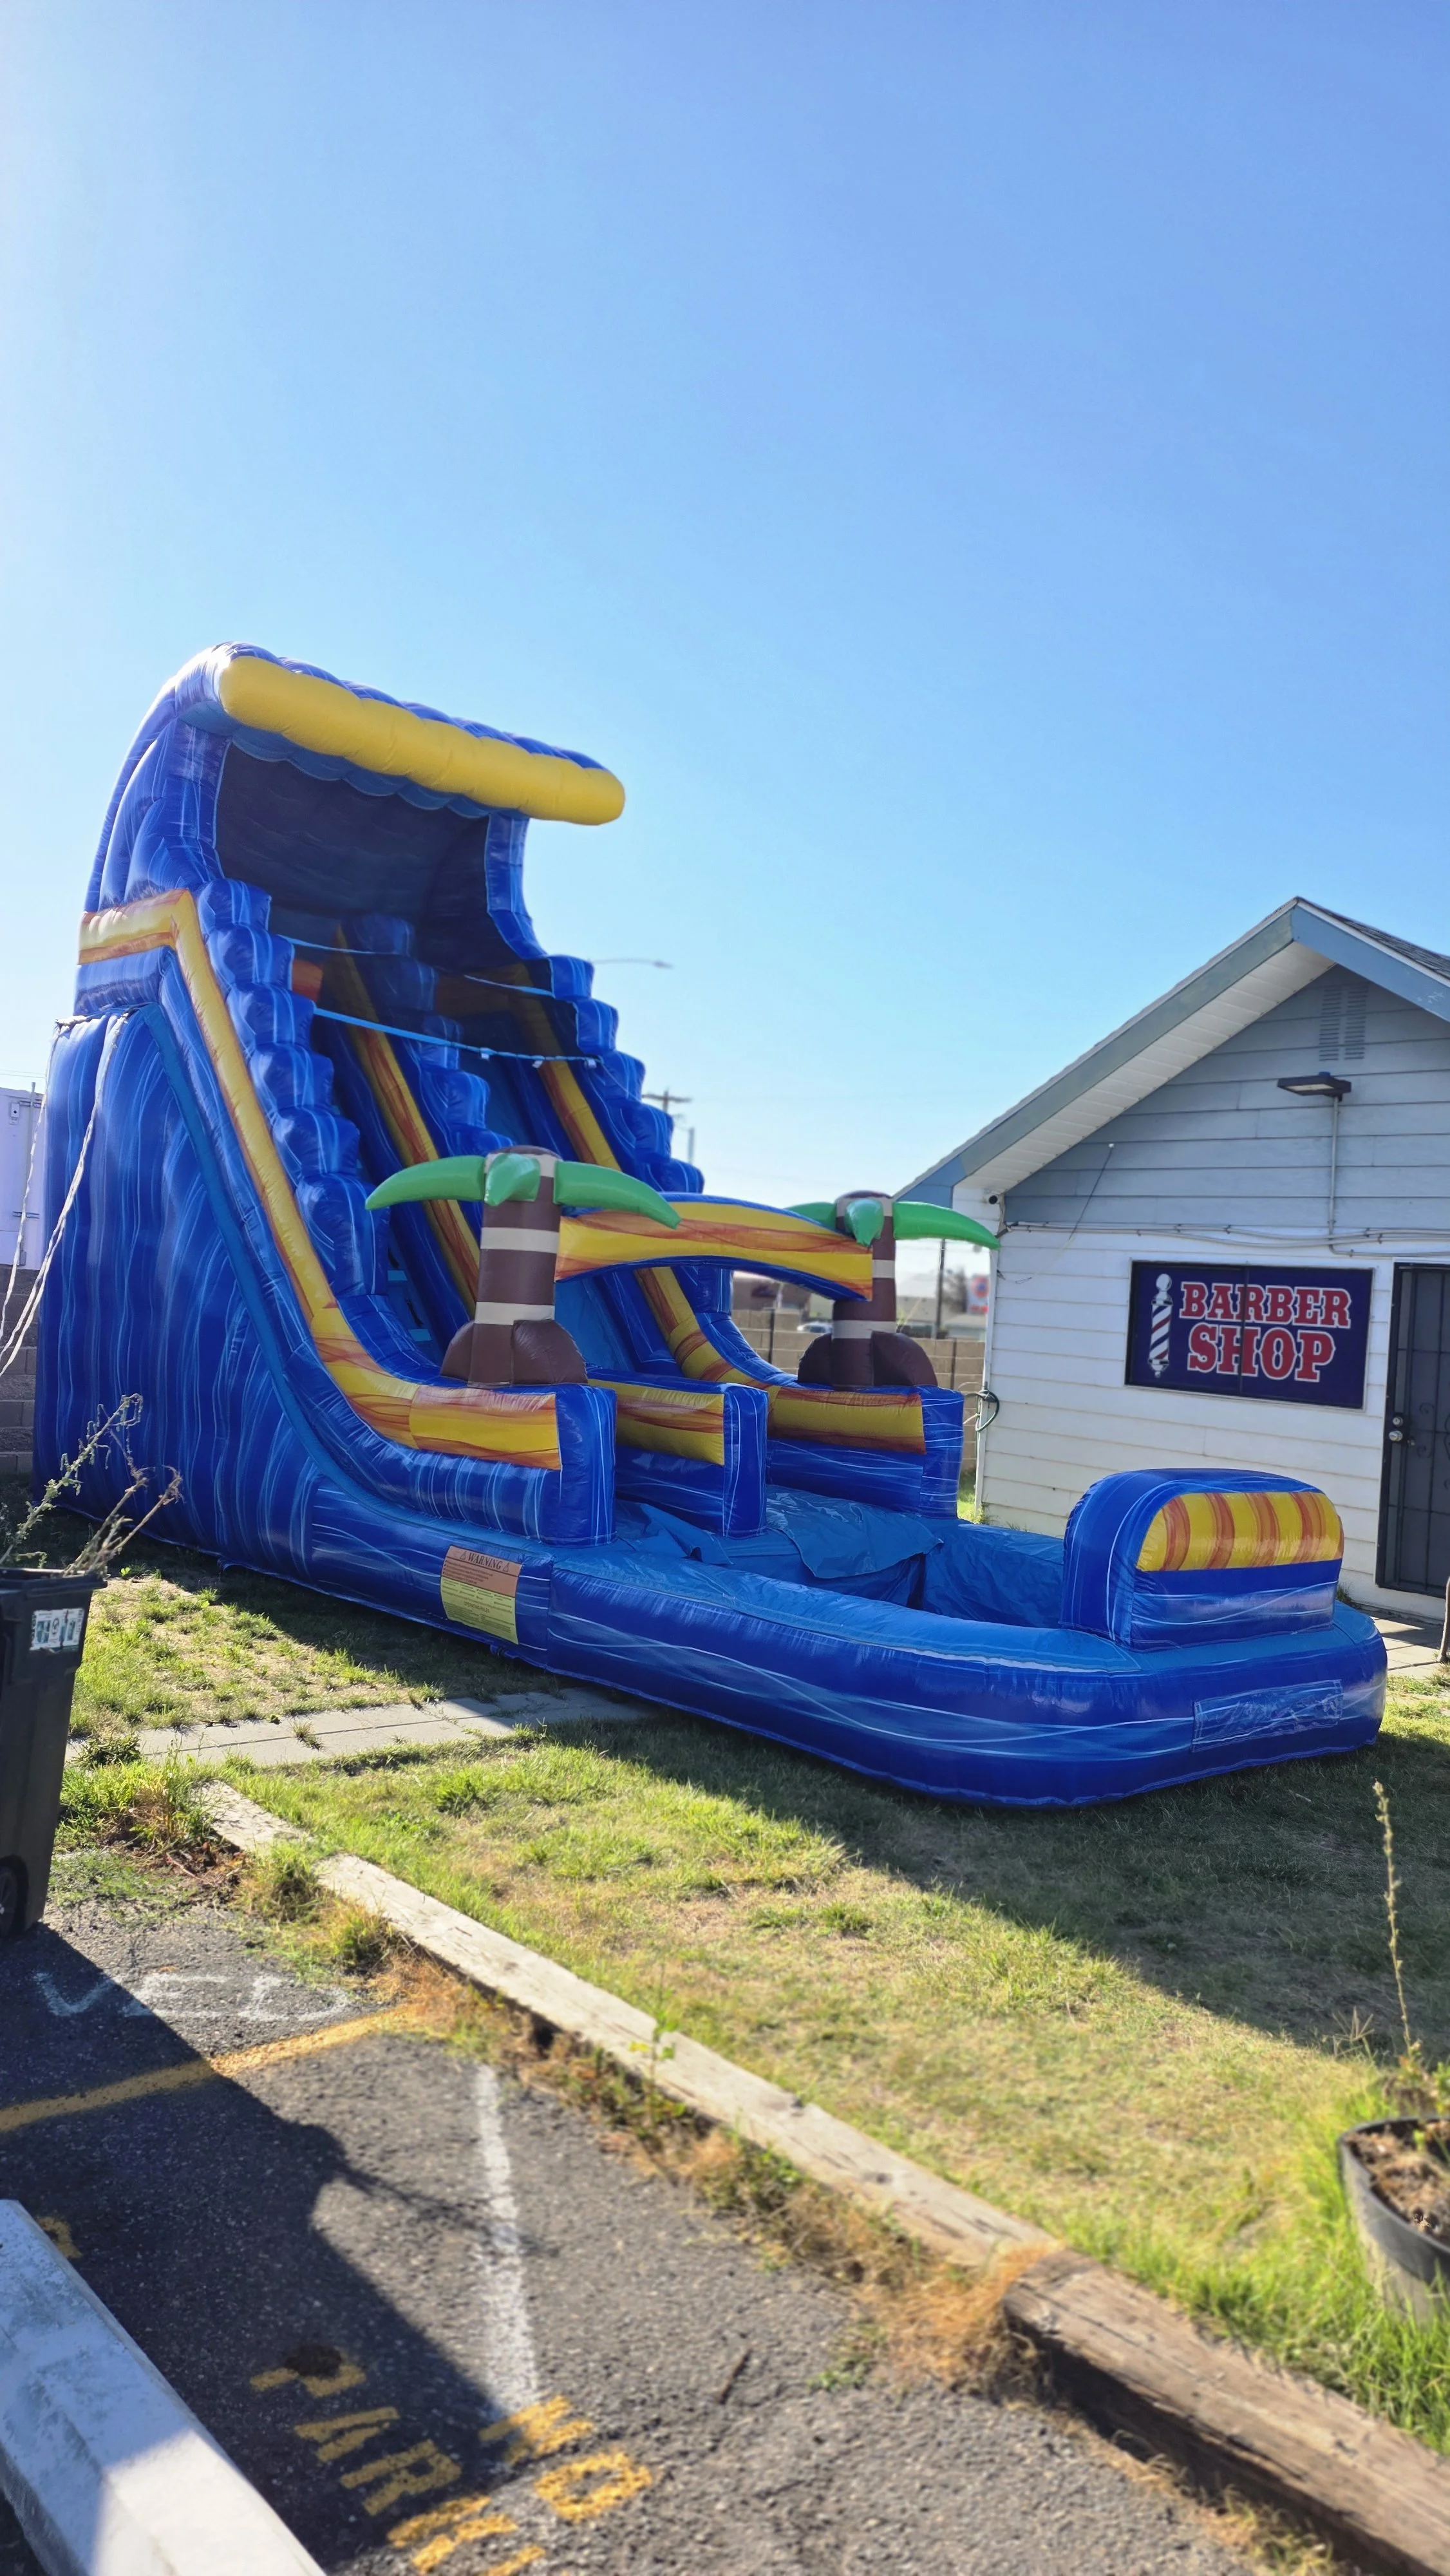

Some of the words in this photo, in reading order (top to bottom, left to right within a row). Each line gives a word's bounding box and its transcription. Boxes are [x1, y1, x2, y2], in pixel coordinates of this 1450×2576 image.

[1179, 1281, 1351, 1329] BARBER
[1187, 1322, 1336, 1383] SHOP
[467, 1552, 503, 1570] WARNING
[479, 2394, 652, 2523] NO
